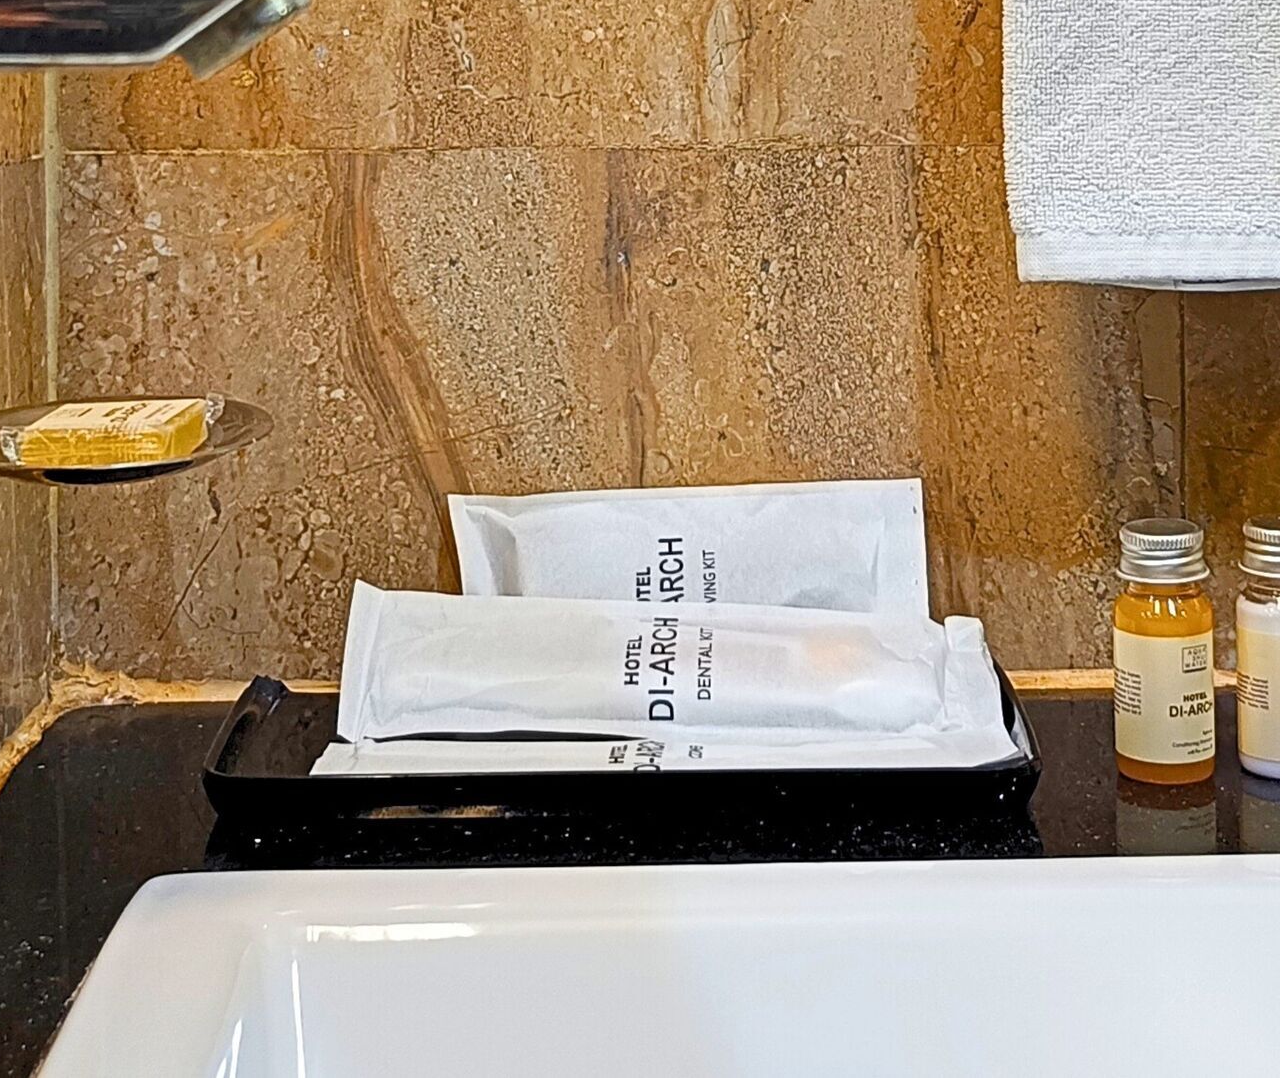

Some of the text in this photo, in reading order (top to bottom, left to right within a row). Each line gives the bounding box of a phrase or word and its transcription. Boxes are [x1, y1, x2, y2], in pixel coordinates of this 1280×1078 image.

[702, 549, 715, 569] KIT
[624, 635, 642, 685] HOTEL
[648, 617, 679, 721] DI-ARCH
[697, 627, 713, 700] DENTAL KIT
[1183, 691, 1207, 702] HOTEL
